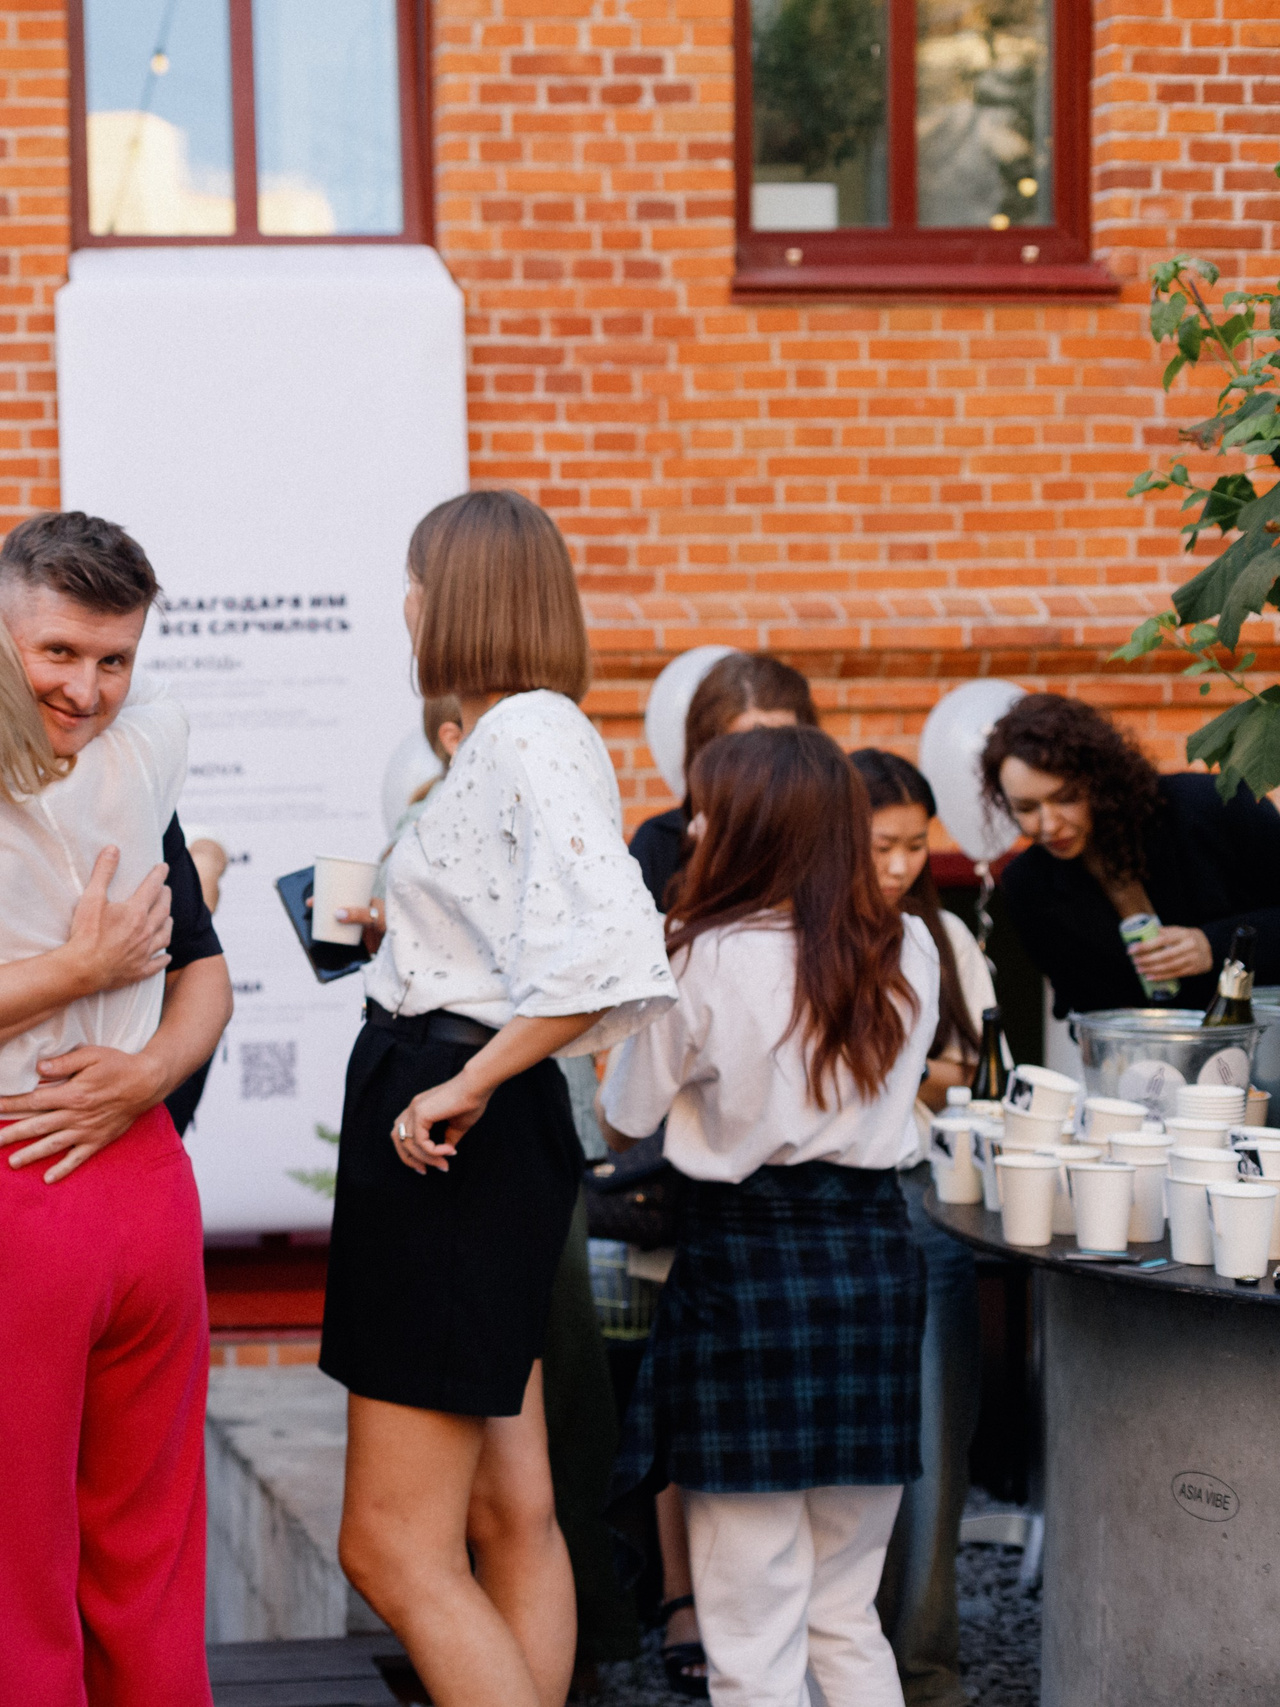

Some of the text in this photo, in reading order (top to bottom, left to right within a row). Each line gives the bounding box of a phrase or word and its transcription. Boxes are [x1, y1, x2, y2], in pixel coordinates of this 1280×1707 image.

[160, 616, 350, 636] ВСЕ СЛУЧИЛОСЬ
[1179, 1482, 1231, 1510] ASIA VIBE
